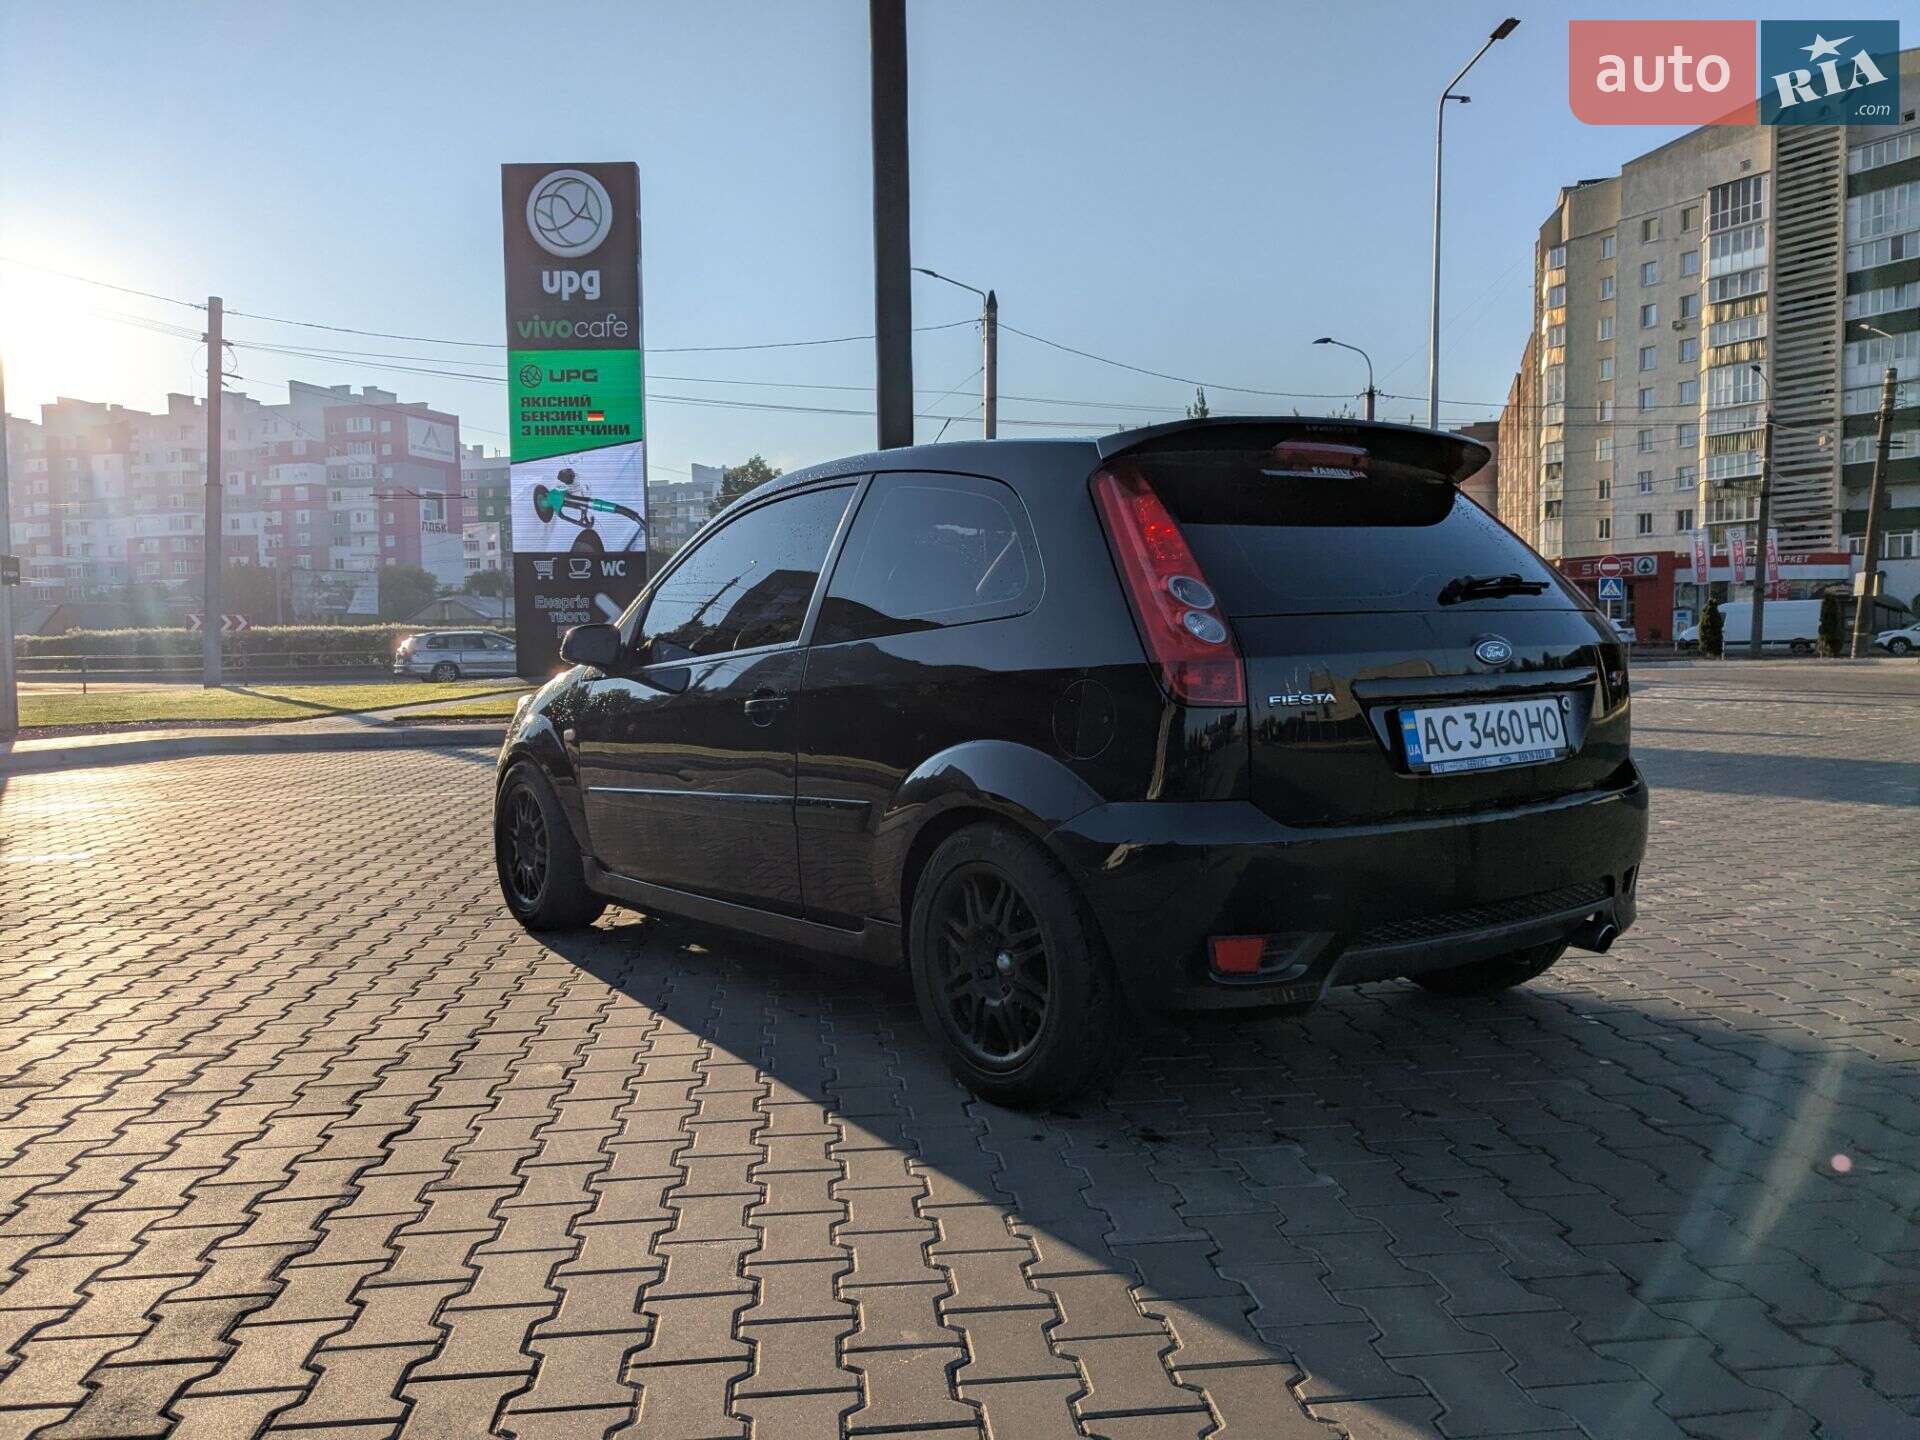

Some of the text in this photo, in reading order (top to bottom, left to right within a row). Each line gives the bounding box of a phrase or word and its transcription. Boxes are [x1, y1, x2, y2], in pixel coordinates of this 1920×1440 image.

[542, 270, 600, 300] upg
[517, 314, 628, 338] vivocafe
[548, 369, 598, 382] UPG
[521, 394, 591, 407] ЯКІСНИЙ
[521, 411, 582, 421] БЕНЗИН
[521, 424, 630, 436] З НІМЕЧЧИНИ
[601, 560, 626, 577] WC
[1268, 692, 1338, 707] FIESTA
[1407, 744, 1421, 755] UA
